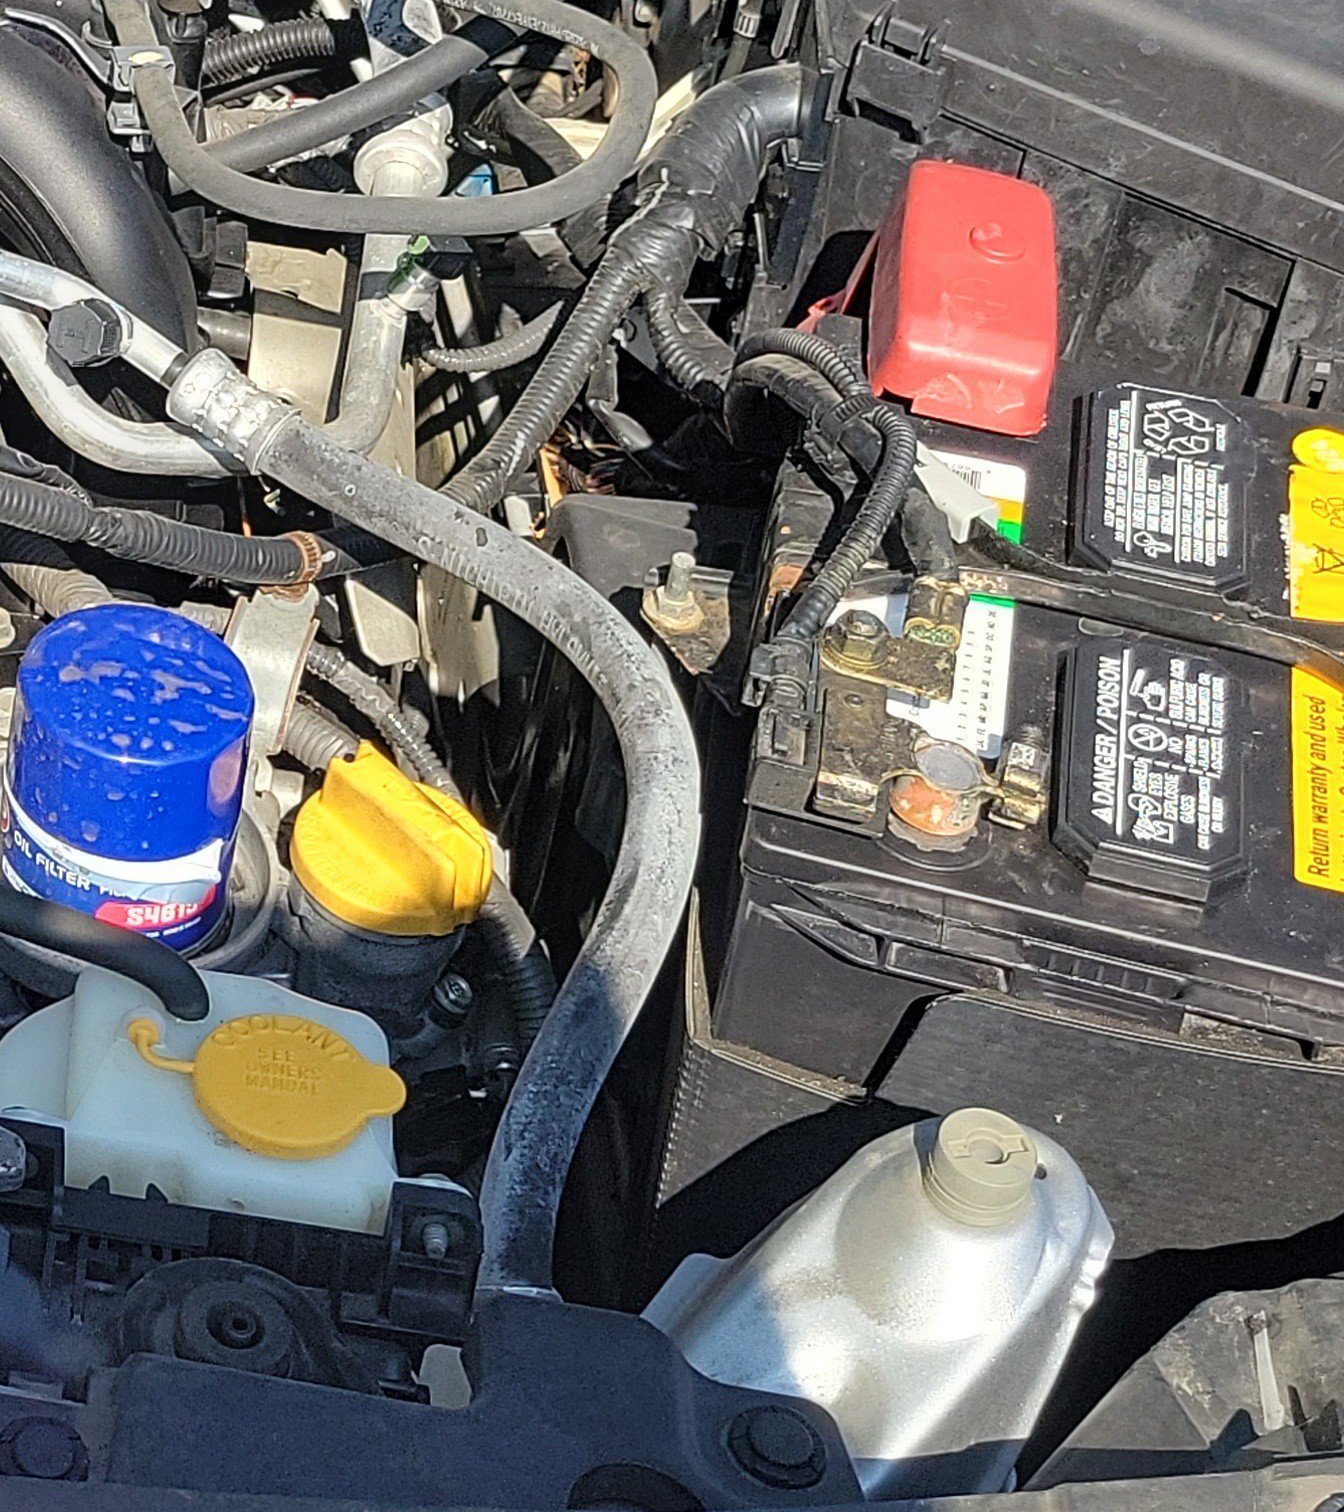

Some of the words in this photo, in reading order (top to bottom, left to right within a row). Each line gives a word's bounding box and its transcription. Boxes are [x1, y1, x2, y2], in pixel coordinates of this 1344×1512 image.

[1096, 656, 1121, 720] POISON
[1302, 694, 1326, 730] used
[1092, 733, 1118, 804] DANGER
[1168, 737, 1184, 755] NO
[1303, 730, 1326, 761] and
[1306, 763, 1332, 824] warranty
[14, 830, 32, 859] OIL
[35, 853, 91, 891] FILTER
[1308, 829, 1330, 879] Return
[213, 1016, 357, 1062] COOLANT
